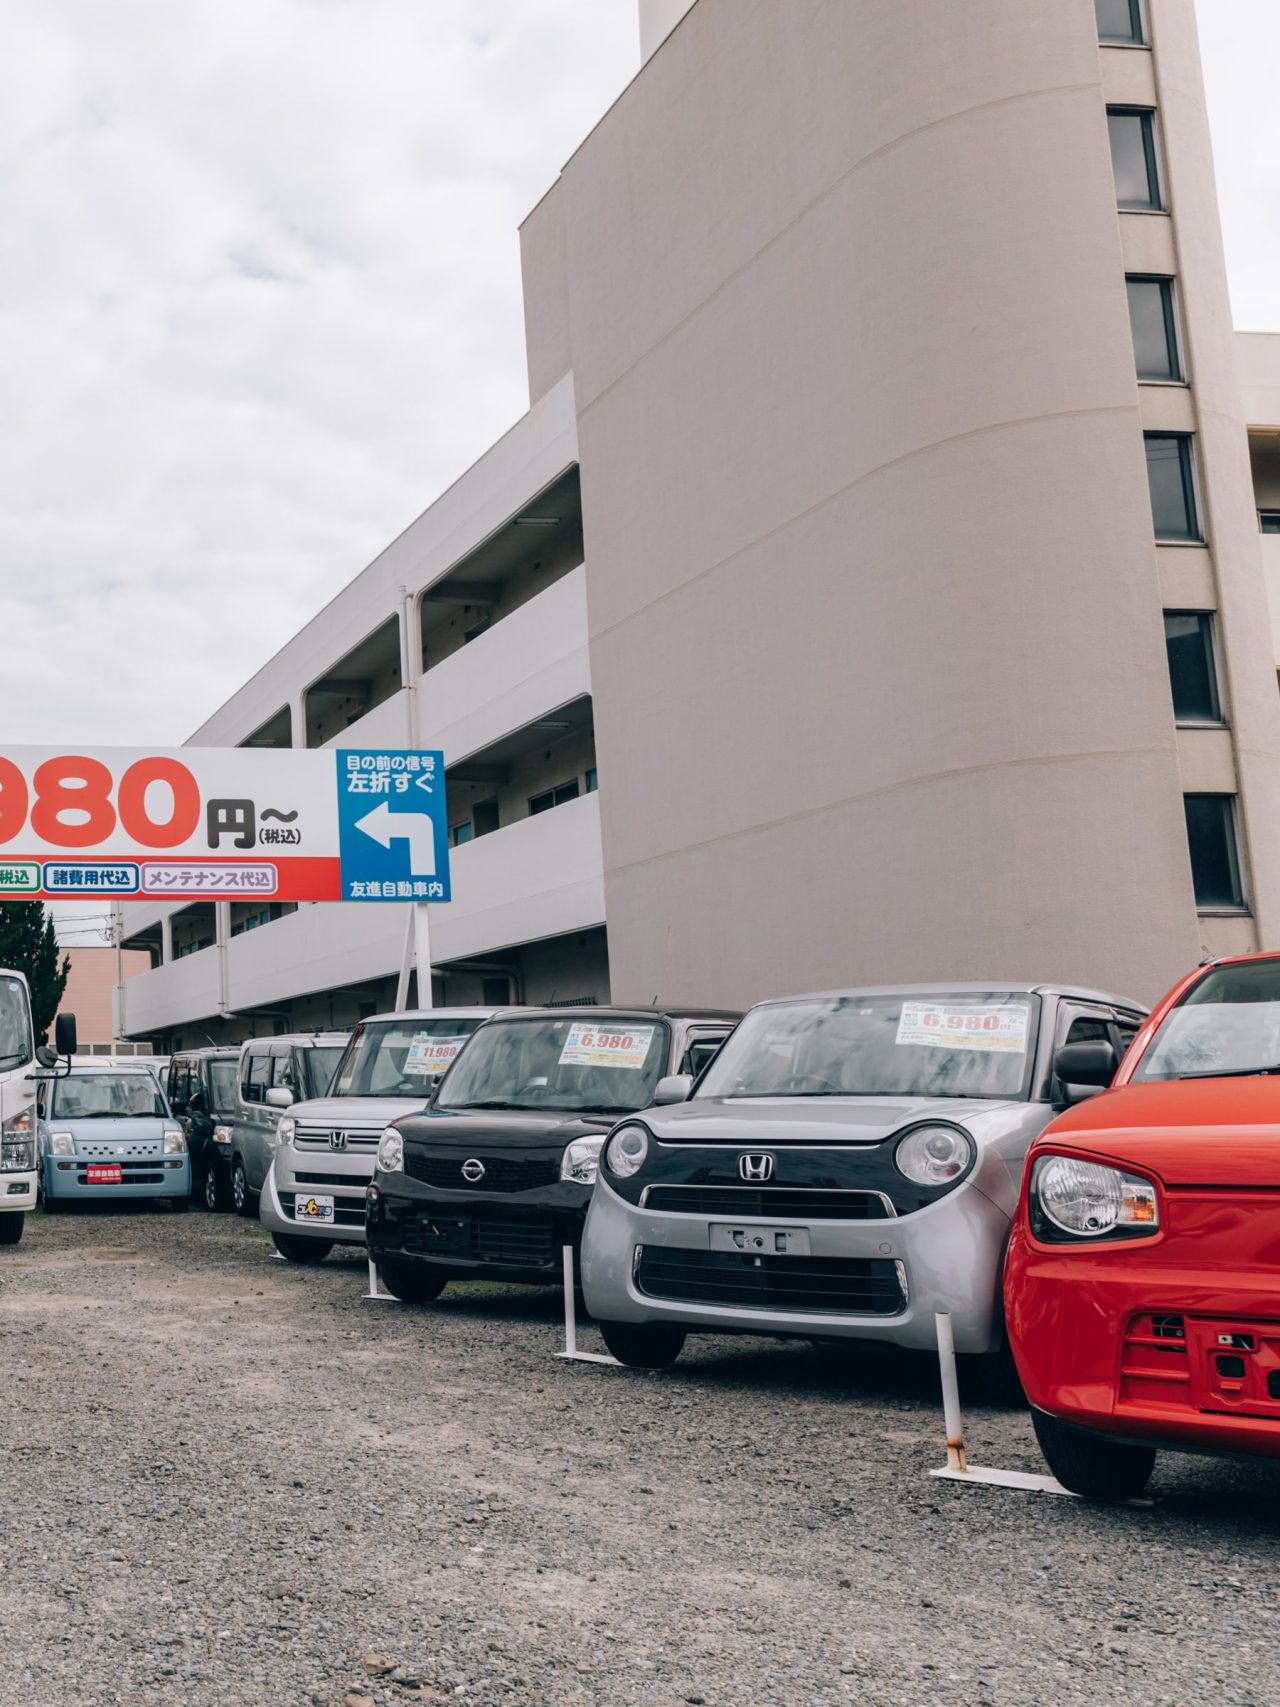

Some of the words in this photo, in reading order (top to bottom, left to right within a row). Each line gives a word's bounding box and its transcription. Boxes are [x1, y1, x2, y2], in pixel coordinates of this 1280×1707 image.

[346, 755, 436, 772] 目の前の信号
[346, 771, 435, 794] 左折すぐ
[259, 828, 302, 845] (税込)
[53, 869, 130, 886] 諸費用代込
[149, 870, 271, 888] メンテナンス代込
[349, 881, 444, 898] 友進自動車内
